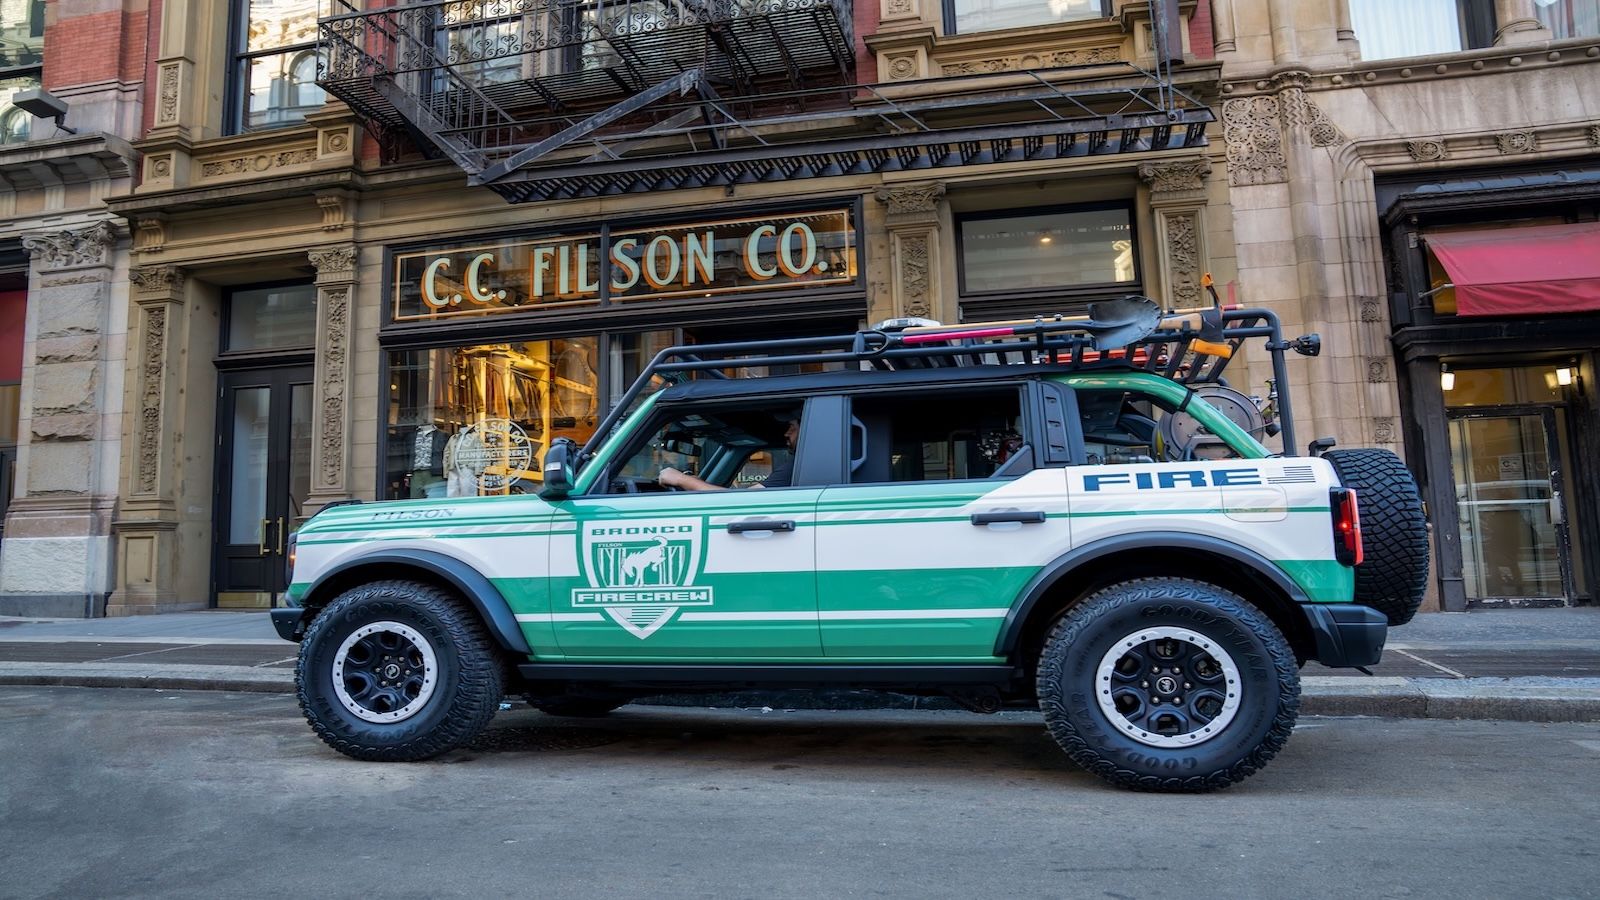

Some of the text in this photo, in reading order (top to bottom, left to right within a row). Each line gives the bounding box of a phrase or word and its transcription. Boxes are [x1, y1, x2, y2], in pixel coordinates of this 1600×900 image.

[531, 230, 715, 298] FILSON
[743, 222, 829, 281] CO.
[1083, 468, 1262, 492] FIRE
[592, 525, 693, 536] BRONCO
[577, 591, 708, 603] FIRECREW
